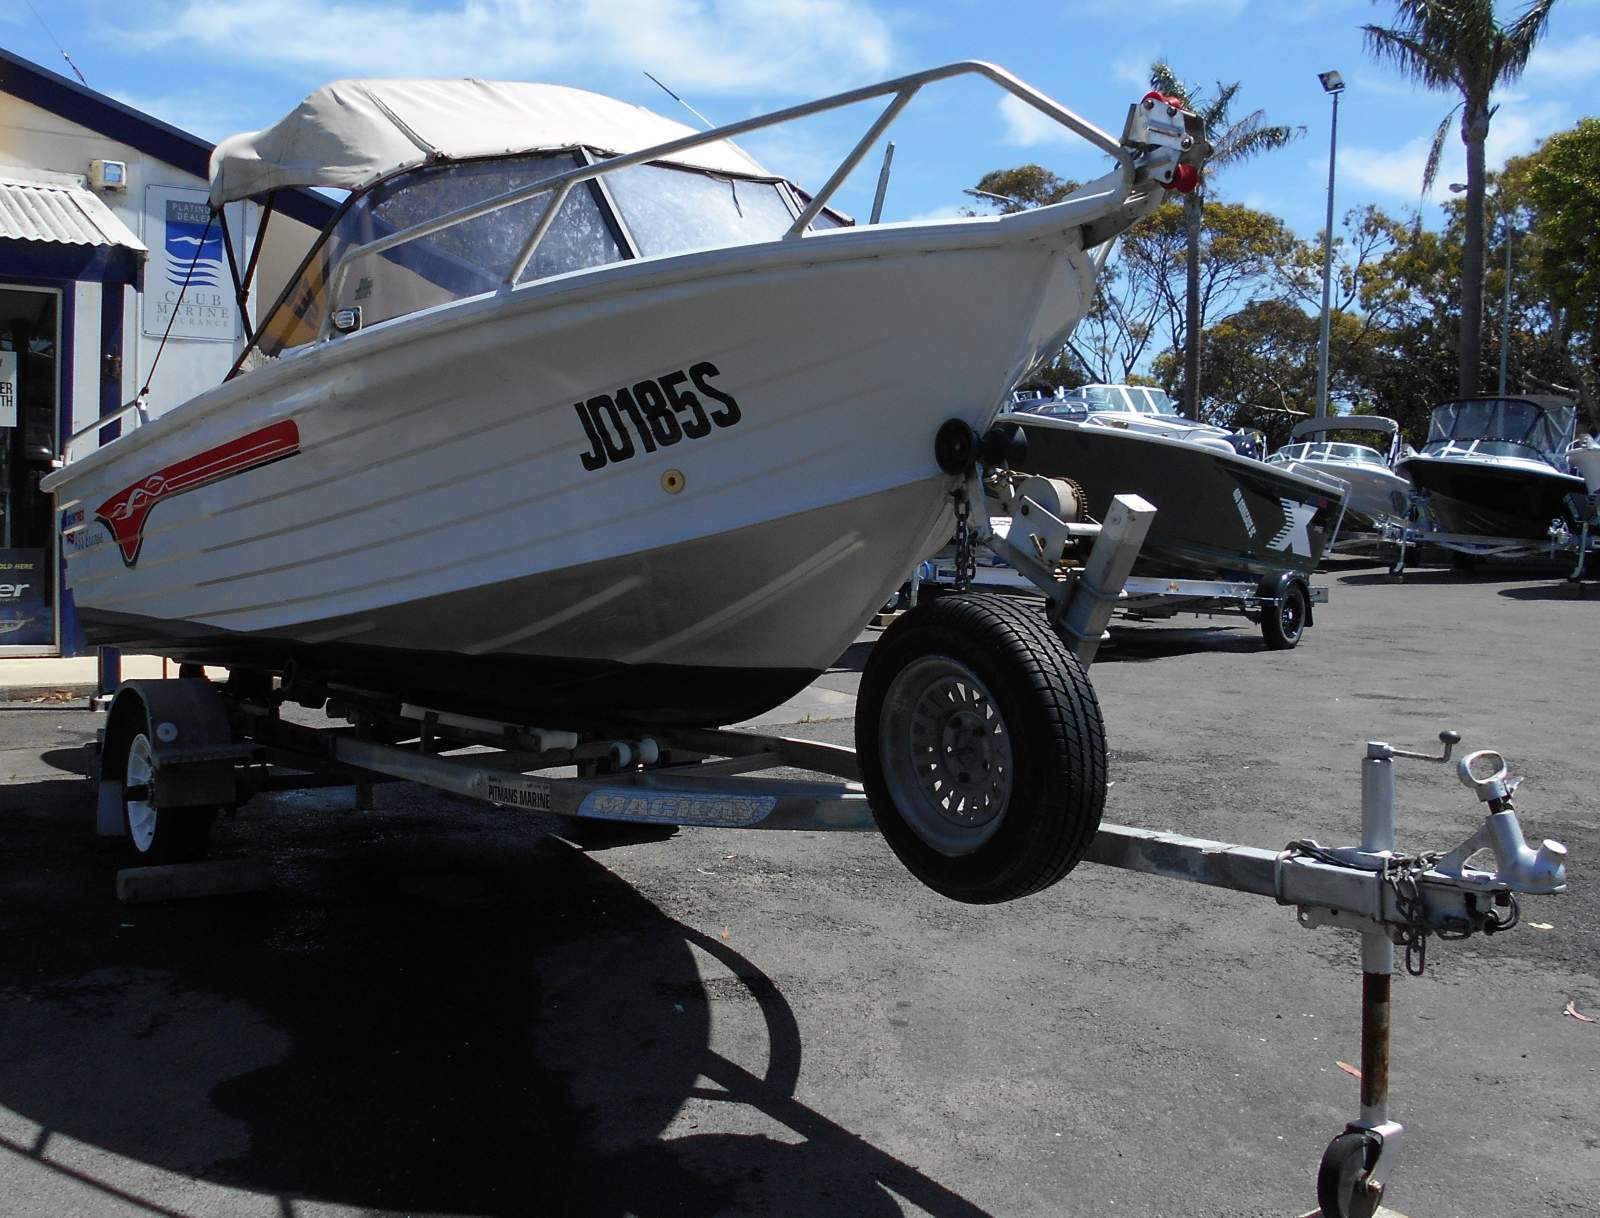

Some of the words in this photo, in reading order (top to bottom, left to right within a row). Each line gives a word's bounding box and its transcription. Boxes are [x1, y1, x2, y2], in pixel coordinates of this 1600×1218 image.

[172, 202, 211, 214] PLATINU
[164, 290, 222, 306] CLUB
[488, 784, 519, 804] PITMANS
[519, 790, 551, 809] MARINE
